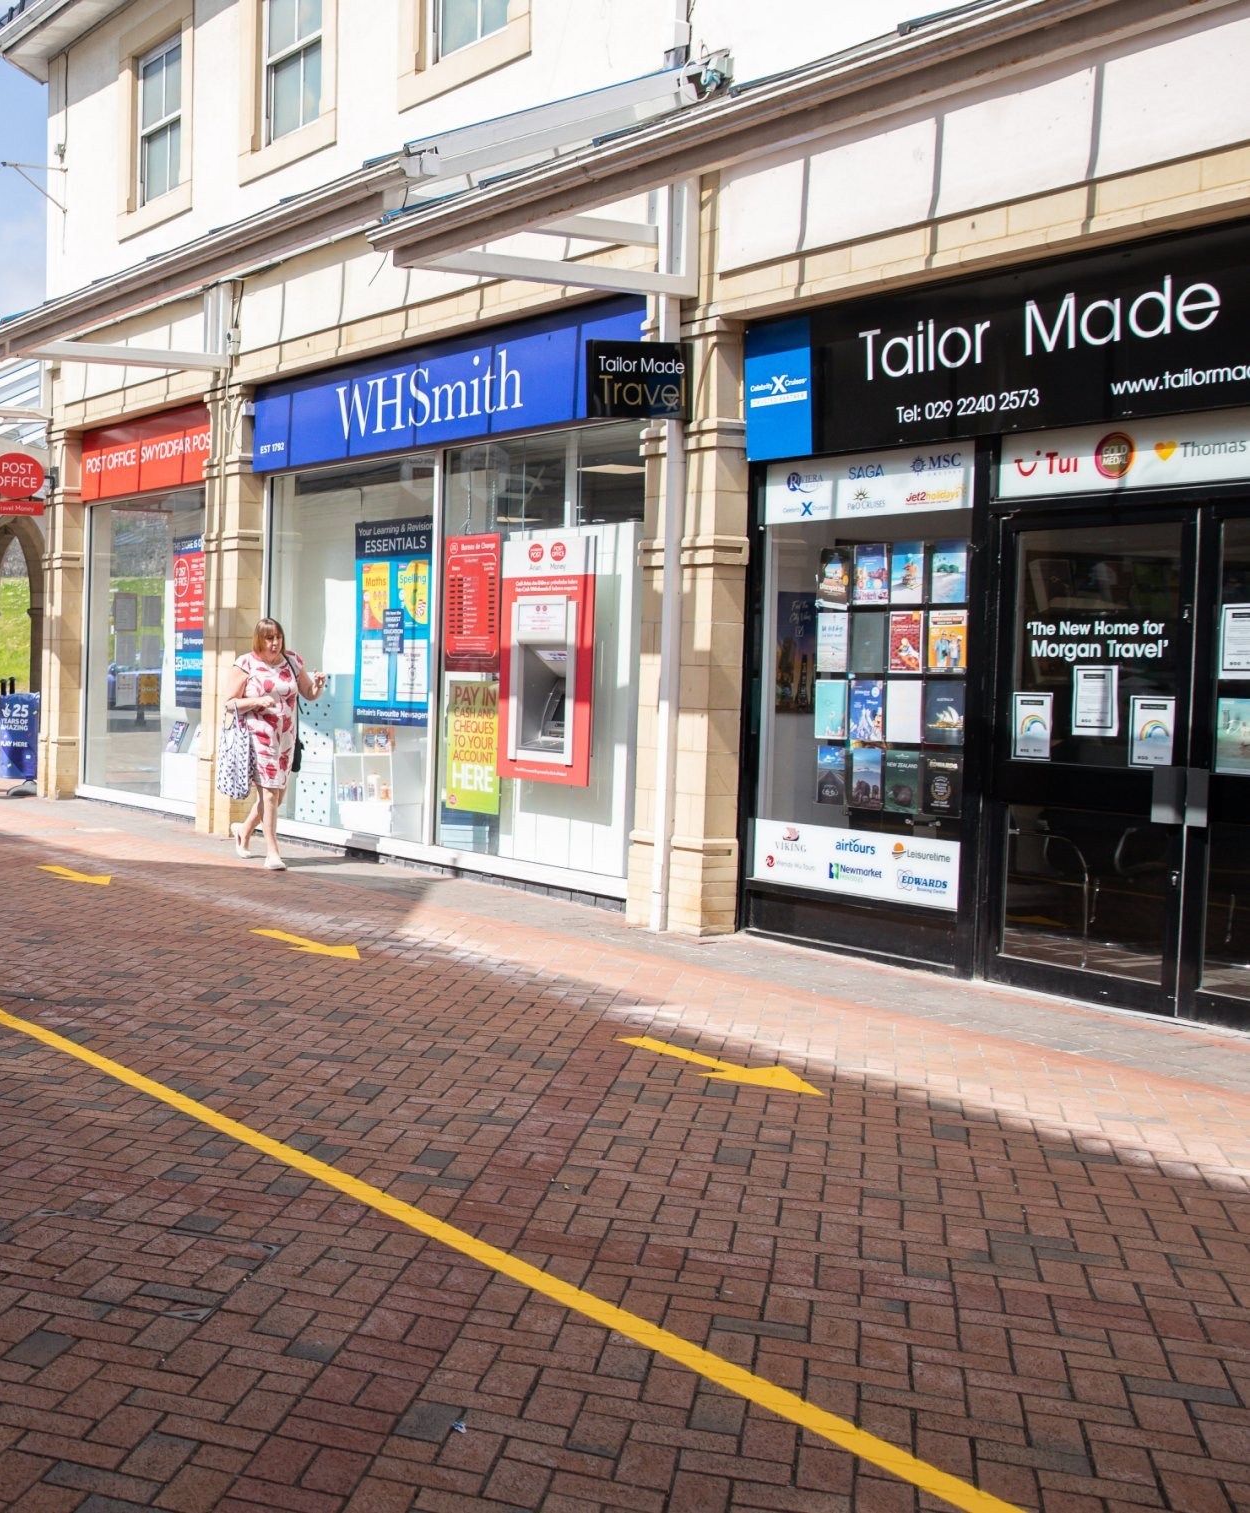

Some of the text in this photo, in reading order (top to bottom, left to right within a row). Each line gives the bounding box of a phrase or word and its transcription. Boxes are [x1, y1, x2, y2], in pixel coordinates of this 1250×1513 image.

[858, 274, 1221, 381] Tailor Made
[598, 355, 685, 374] Tailor Made
[335, 349, 524, 441] WHSmith
[598, 374, 686, 406] Travel
[896, 387, 1040, 423] Tel: 029 2240 2573
[259, 441, 285, 455] EST 1792
[1102, 444, 1129, 456] GOLD
[1179, 440, 1248, 458] Thomas
[85, 455, 107, 475] POST
[107, 448, 137, 469] OFFICE
[928, 452, 962, 470] MSC
[1101, 454, 1128, 467] MEDAL
[1, 462, 34, 475] POST
[848, 463, 885, 480] SAGA
[358, 528, 372, 537] Your
[372, 525, 400, 536] Learning
[364, 536, 427, 553] ESSENTIALS
[365, 577, 387, 588] Maths
[399, 574, 427, 585] Spelling
[1059, 620, 1092, 636] New
[1094, 620, 1140, 635] Home
[1142, 620, 1165, 635] for
[1030, 639, 1102, 662] Morgan
[453, 685, 497, 707] PAY IN
[12, 703, 30, 718] 25
[376, 709, 400, 719] Favourite
[453, 706, 495, 720] CASH AND
[1, 718, 29, 726] YEARS OF
[453, 719, 495, 735] CHEQUES
[0, 740, 12, 748] PLAY
[453, 734, 494, 750] TO YOUR
[452, 749, 494, 764] ACCOUNT
[451, 762, 495, 793] HERE
[775, 841, 807, 853] VIKING
[835, 838, 876, 855] airtours
[906, 849, 951, 863] Leisuretime
[840, 864, 882, 879] Newmarket
[901, 875, 949, 889] EDWARDS
